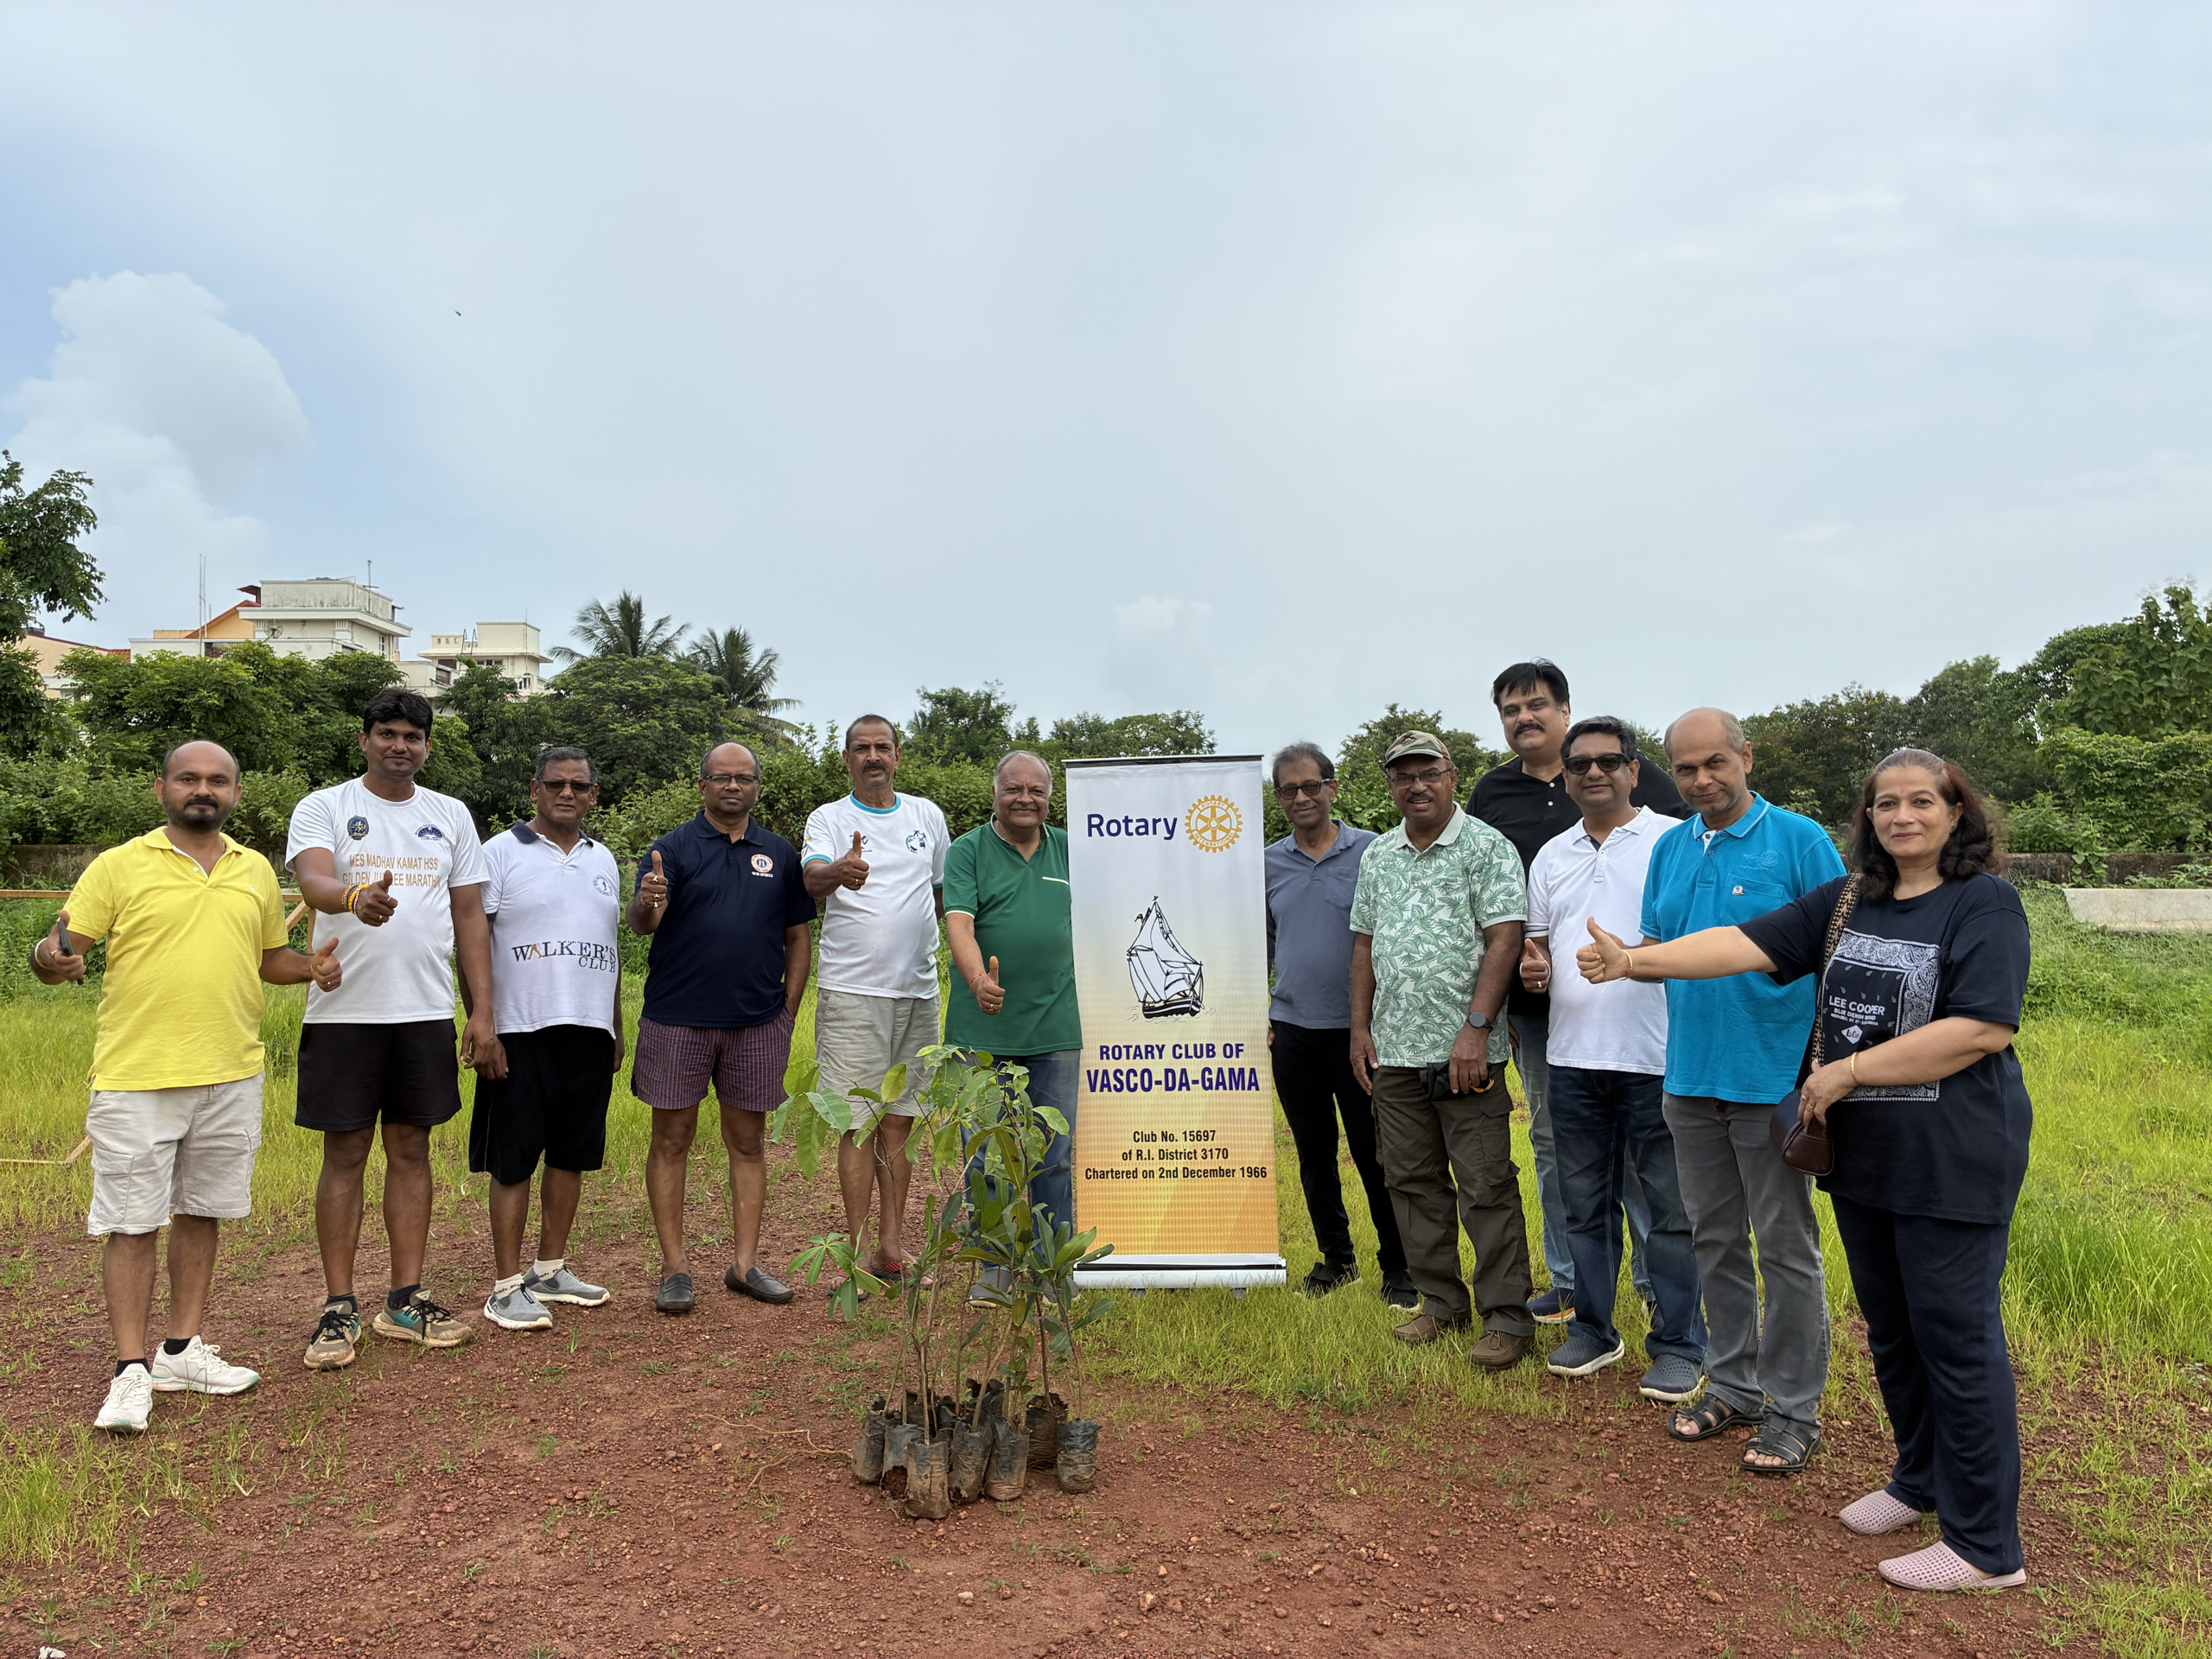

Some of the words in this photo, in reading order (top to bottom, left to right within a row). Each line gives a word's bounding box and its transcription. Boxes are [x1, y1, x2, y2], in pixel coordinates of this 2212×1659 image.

[1087, 813, 1178, 841] Rotary
[1194, 831, 1235, 847] INTERNATIONAL
[350, 854, 365, 868] MES
[366, 854, 395, 869] MADHAV
[397, 857, 423, 870] KAMAT
[423, 857, 438, 870] HSS
[372, 872, 404, 887] JUEE
[578, 956, 616, 974] CLUB
[1829, 995, 1847, 1008] LEE
[1099, 1044, 1166, 1061] ROTARY
[1172, 1043, 1217, 1059] CLUB
[1223, 1043, 1244, 1059] OF
[1086, 1067, 1260, 1093] VASCO-DA-GAMA
[1133, 1130, 1157, 1143] Club
[1161, 1131, 1178, 1143] No.
[1182, 1130, 1216, 1142] 15697
[1122, 1149, 1133, 1161] of
[1136, 1149, 1154, 1161] R.I.
[1159, 1148, 1198, 1160] District
[1201, 1147, 1229, 1160] 3170
[1085, 1168, 1138, 1180] Chartered
[1141, 1170, 1155, 1179] on
[1159, 1167, 1179, 1179] 2nd
[1182, 1166, 1236, 1179] December
[1240, 1166, 1268, 1179] 1966
